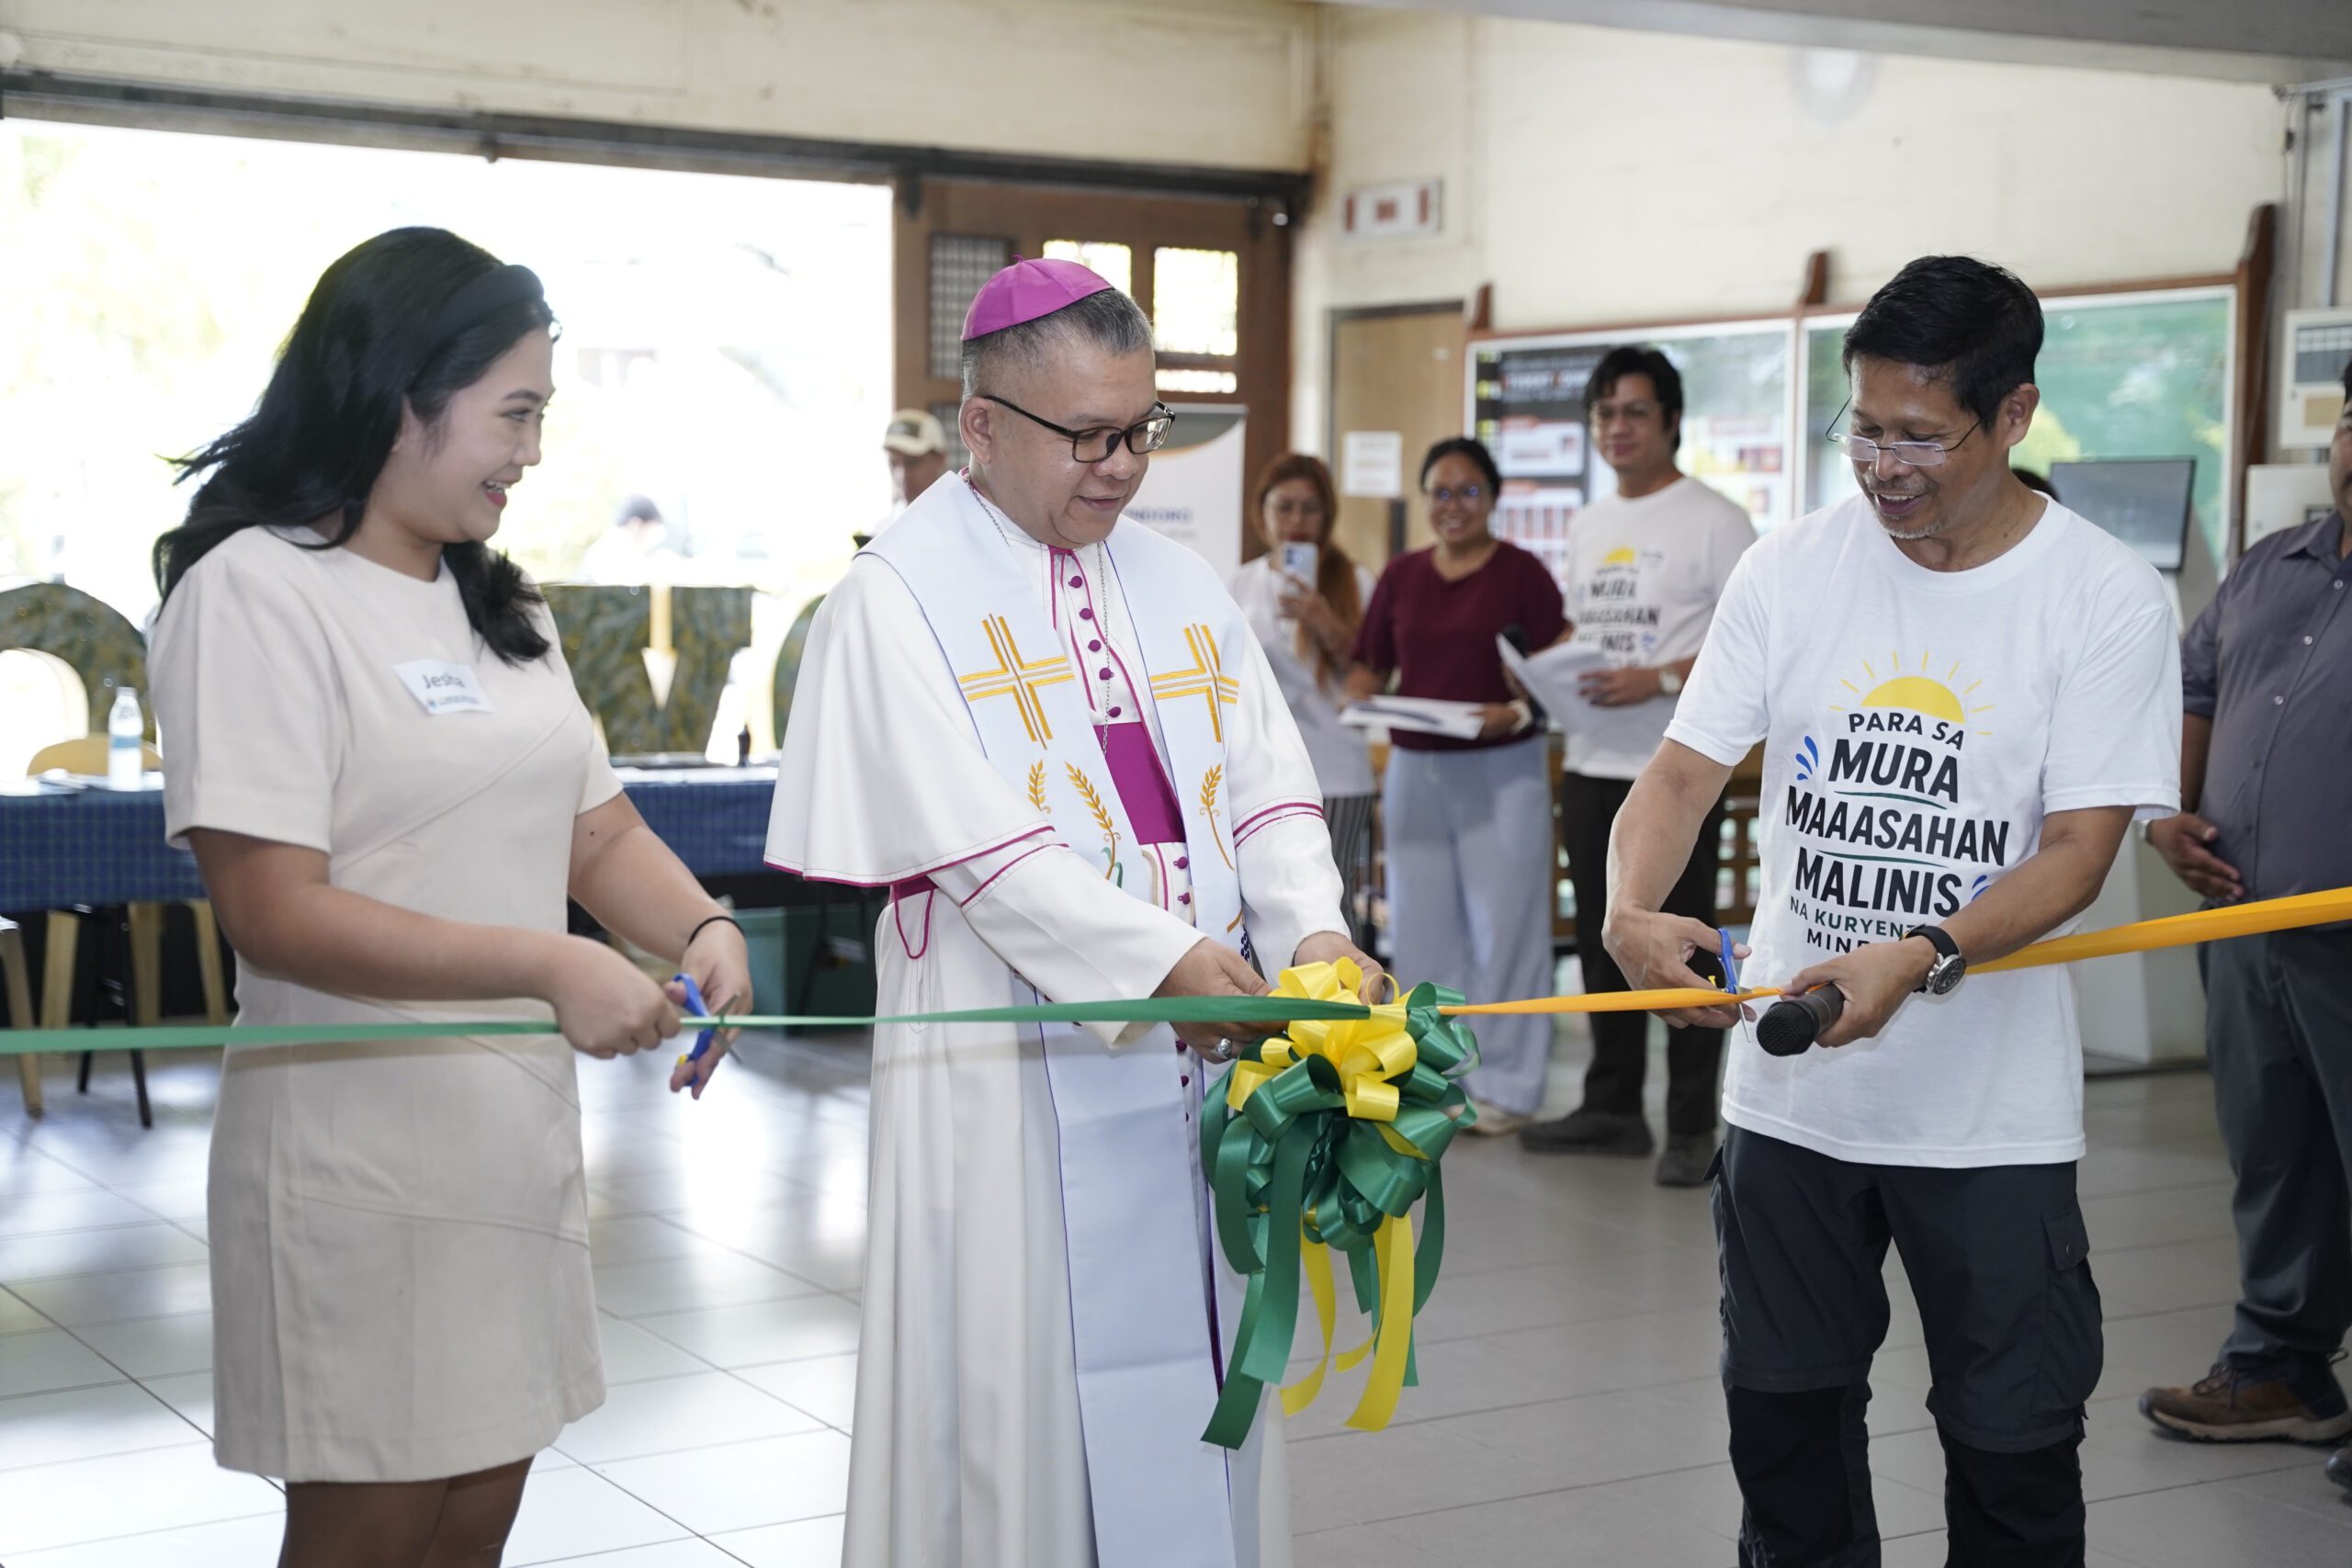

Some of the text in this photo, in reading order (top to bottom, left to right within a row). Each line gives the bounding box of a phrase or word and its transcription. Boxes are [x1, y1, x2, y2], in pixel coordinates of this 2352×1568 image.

[1849, 712, 1964, 750] PARA SA
[1827, 739, 1959, 804] MURA
[1785, 785, 2009, 867] MAAASAHAN
[1791, 896, 1808, 920] NA
[1794, 846, 1962, 918] MALINIS
